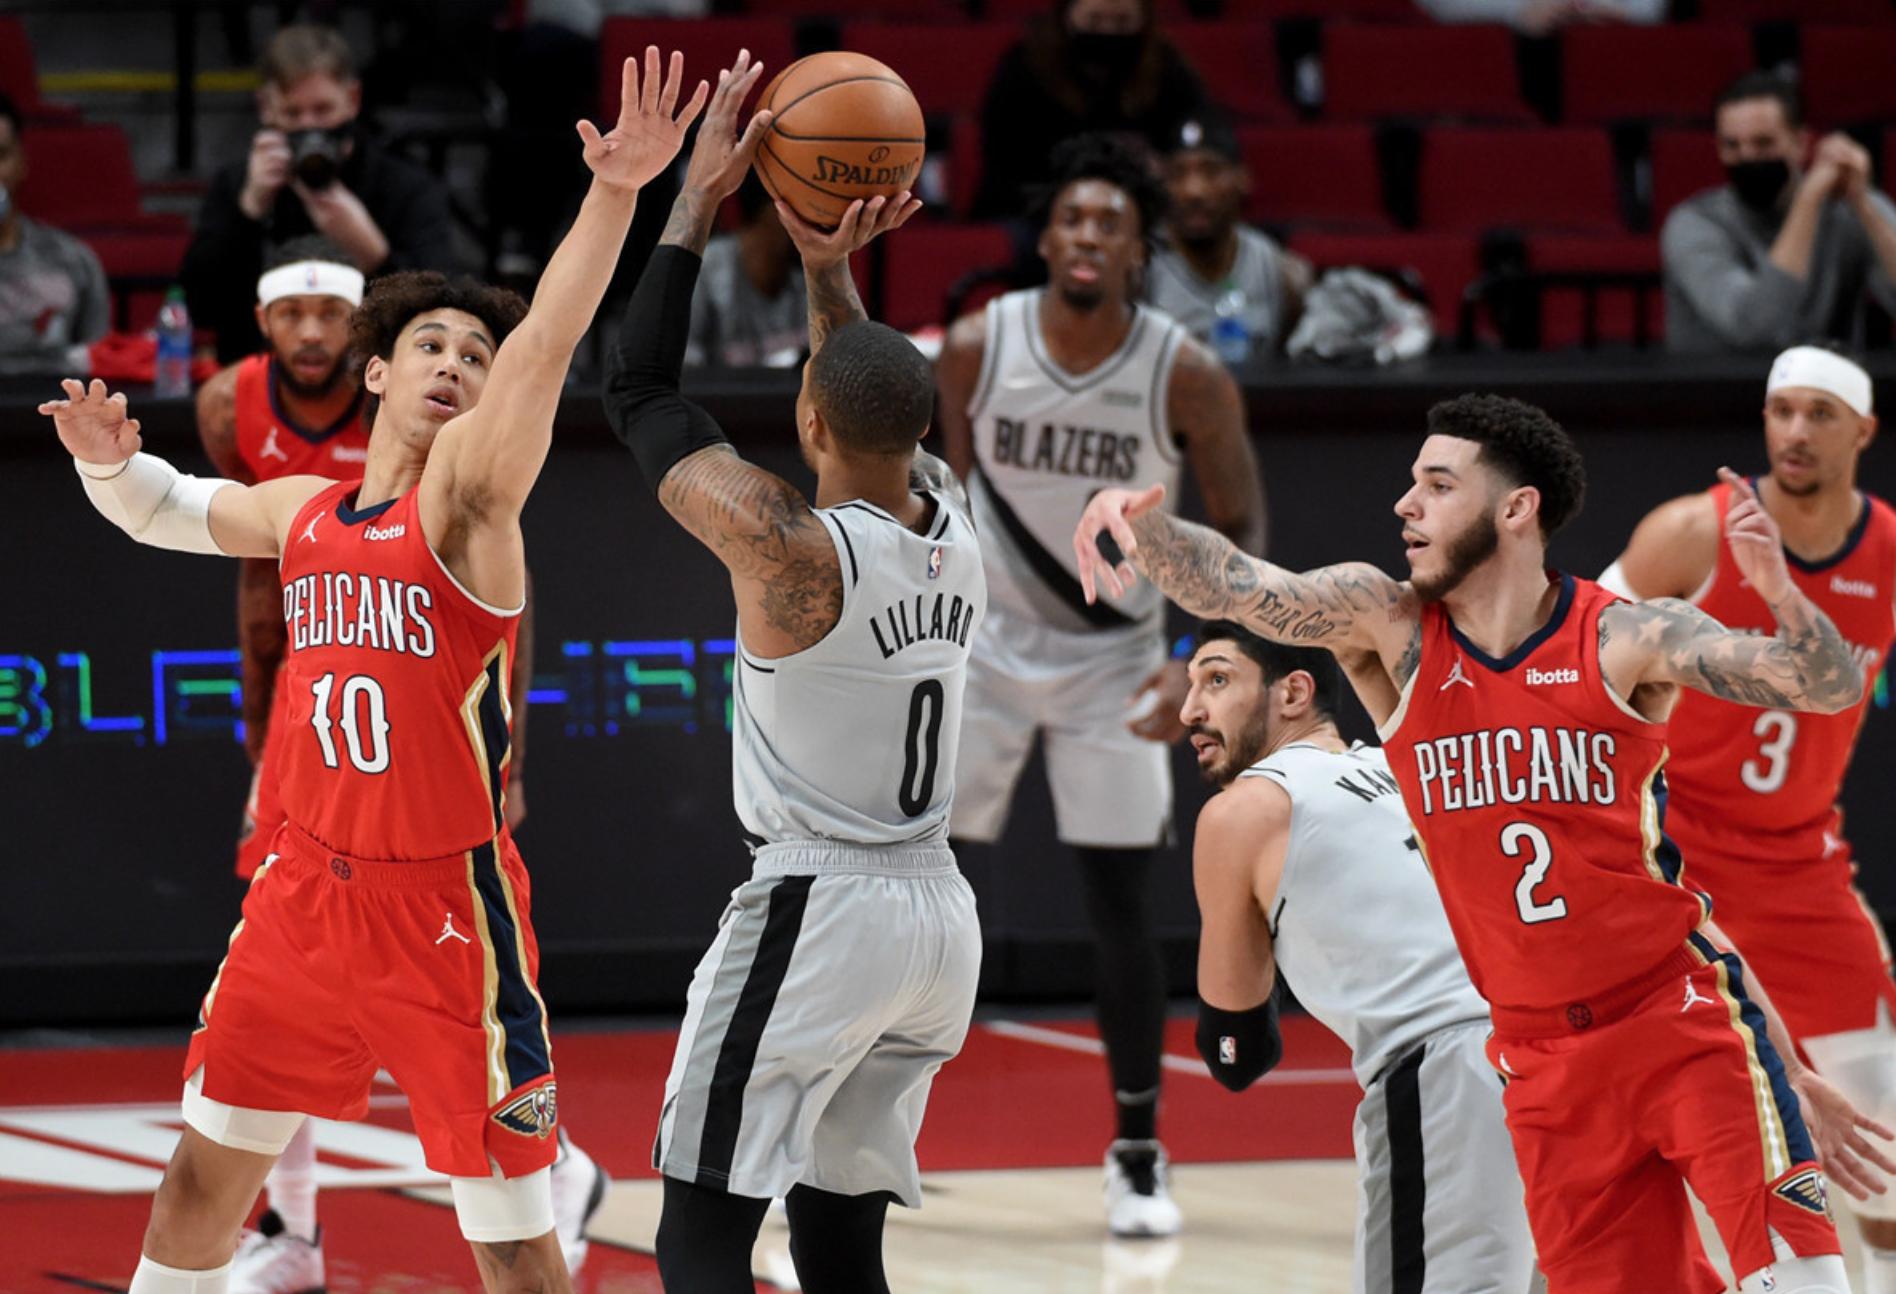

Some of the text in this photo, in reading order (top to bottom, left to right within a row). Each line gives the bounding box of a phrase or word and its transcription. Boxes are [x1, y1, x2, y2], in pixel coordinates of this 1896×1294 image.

[812, 155, 918, 184] SPALDIN
[994, 416, 1140, 483] BLAZERS
[283, 571, 436, 658] PELICANS
[869, 592, 974, 659] LILLARD
[1526, 668, 1579, 685] ibotta
[311, 672, 391, 774] 10
[899, 678, 944, 818] 0
[1740, 709, 1797, 793] 3
[1413, 726, 1616, 816] PELICANS
[1499, 820, 1568, 924] 2
